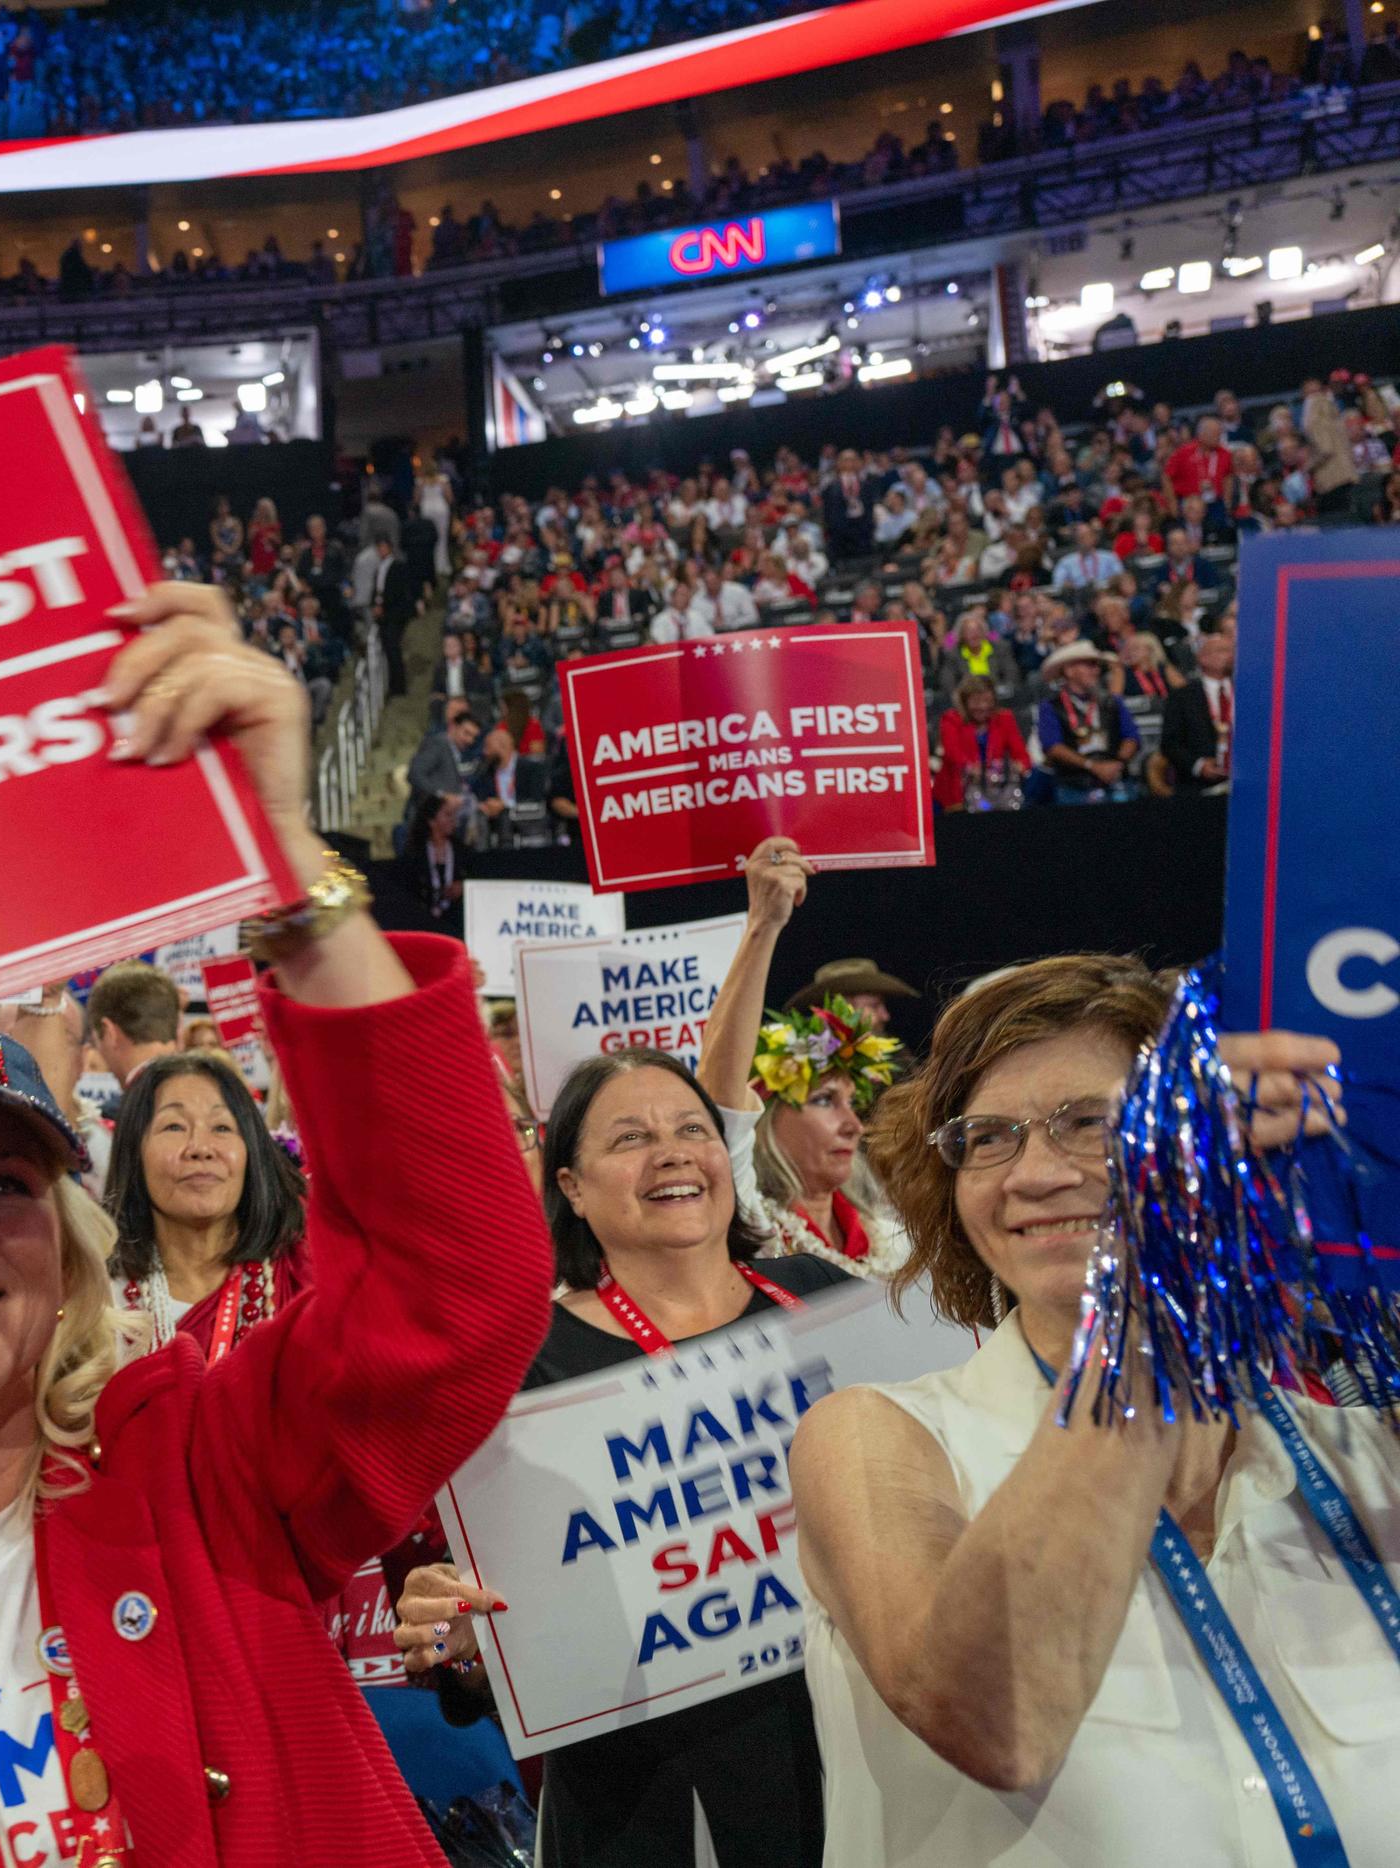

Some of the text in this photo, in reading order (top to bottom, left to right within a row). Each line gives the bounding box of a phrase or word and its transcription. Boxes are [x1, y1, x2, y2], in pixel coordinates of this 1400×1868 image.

[668, 216, 766, 276] CNN
[592, 703, 902, 766] AMERICA FIRST
[708, 746, 793, 773] MEANS
[600, 765, 909, 823] AMERICANS FIRST
[498, 920, 597, 938] AMERICA
[517, 901, 580, 919] MAKE
[602, 956, 700, 993] MAKE
[562, 1438, 793, 1566] AMER
[651, 1502, 797, 1593] SAF
[636, 1568, 803, 1667] AGA
[738, 1634, 806, 1676] 202
[1253, 1712, 1311, 1821] FREESPOKE
